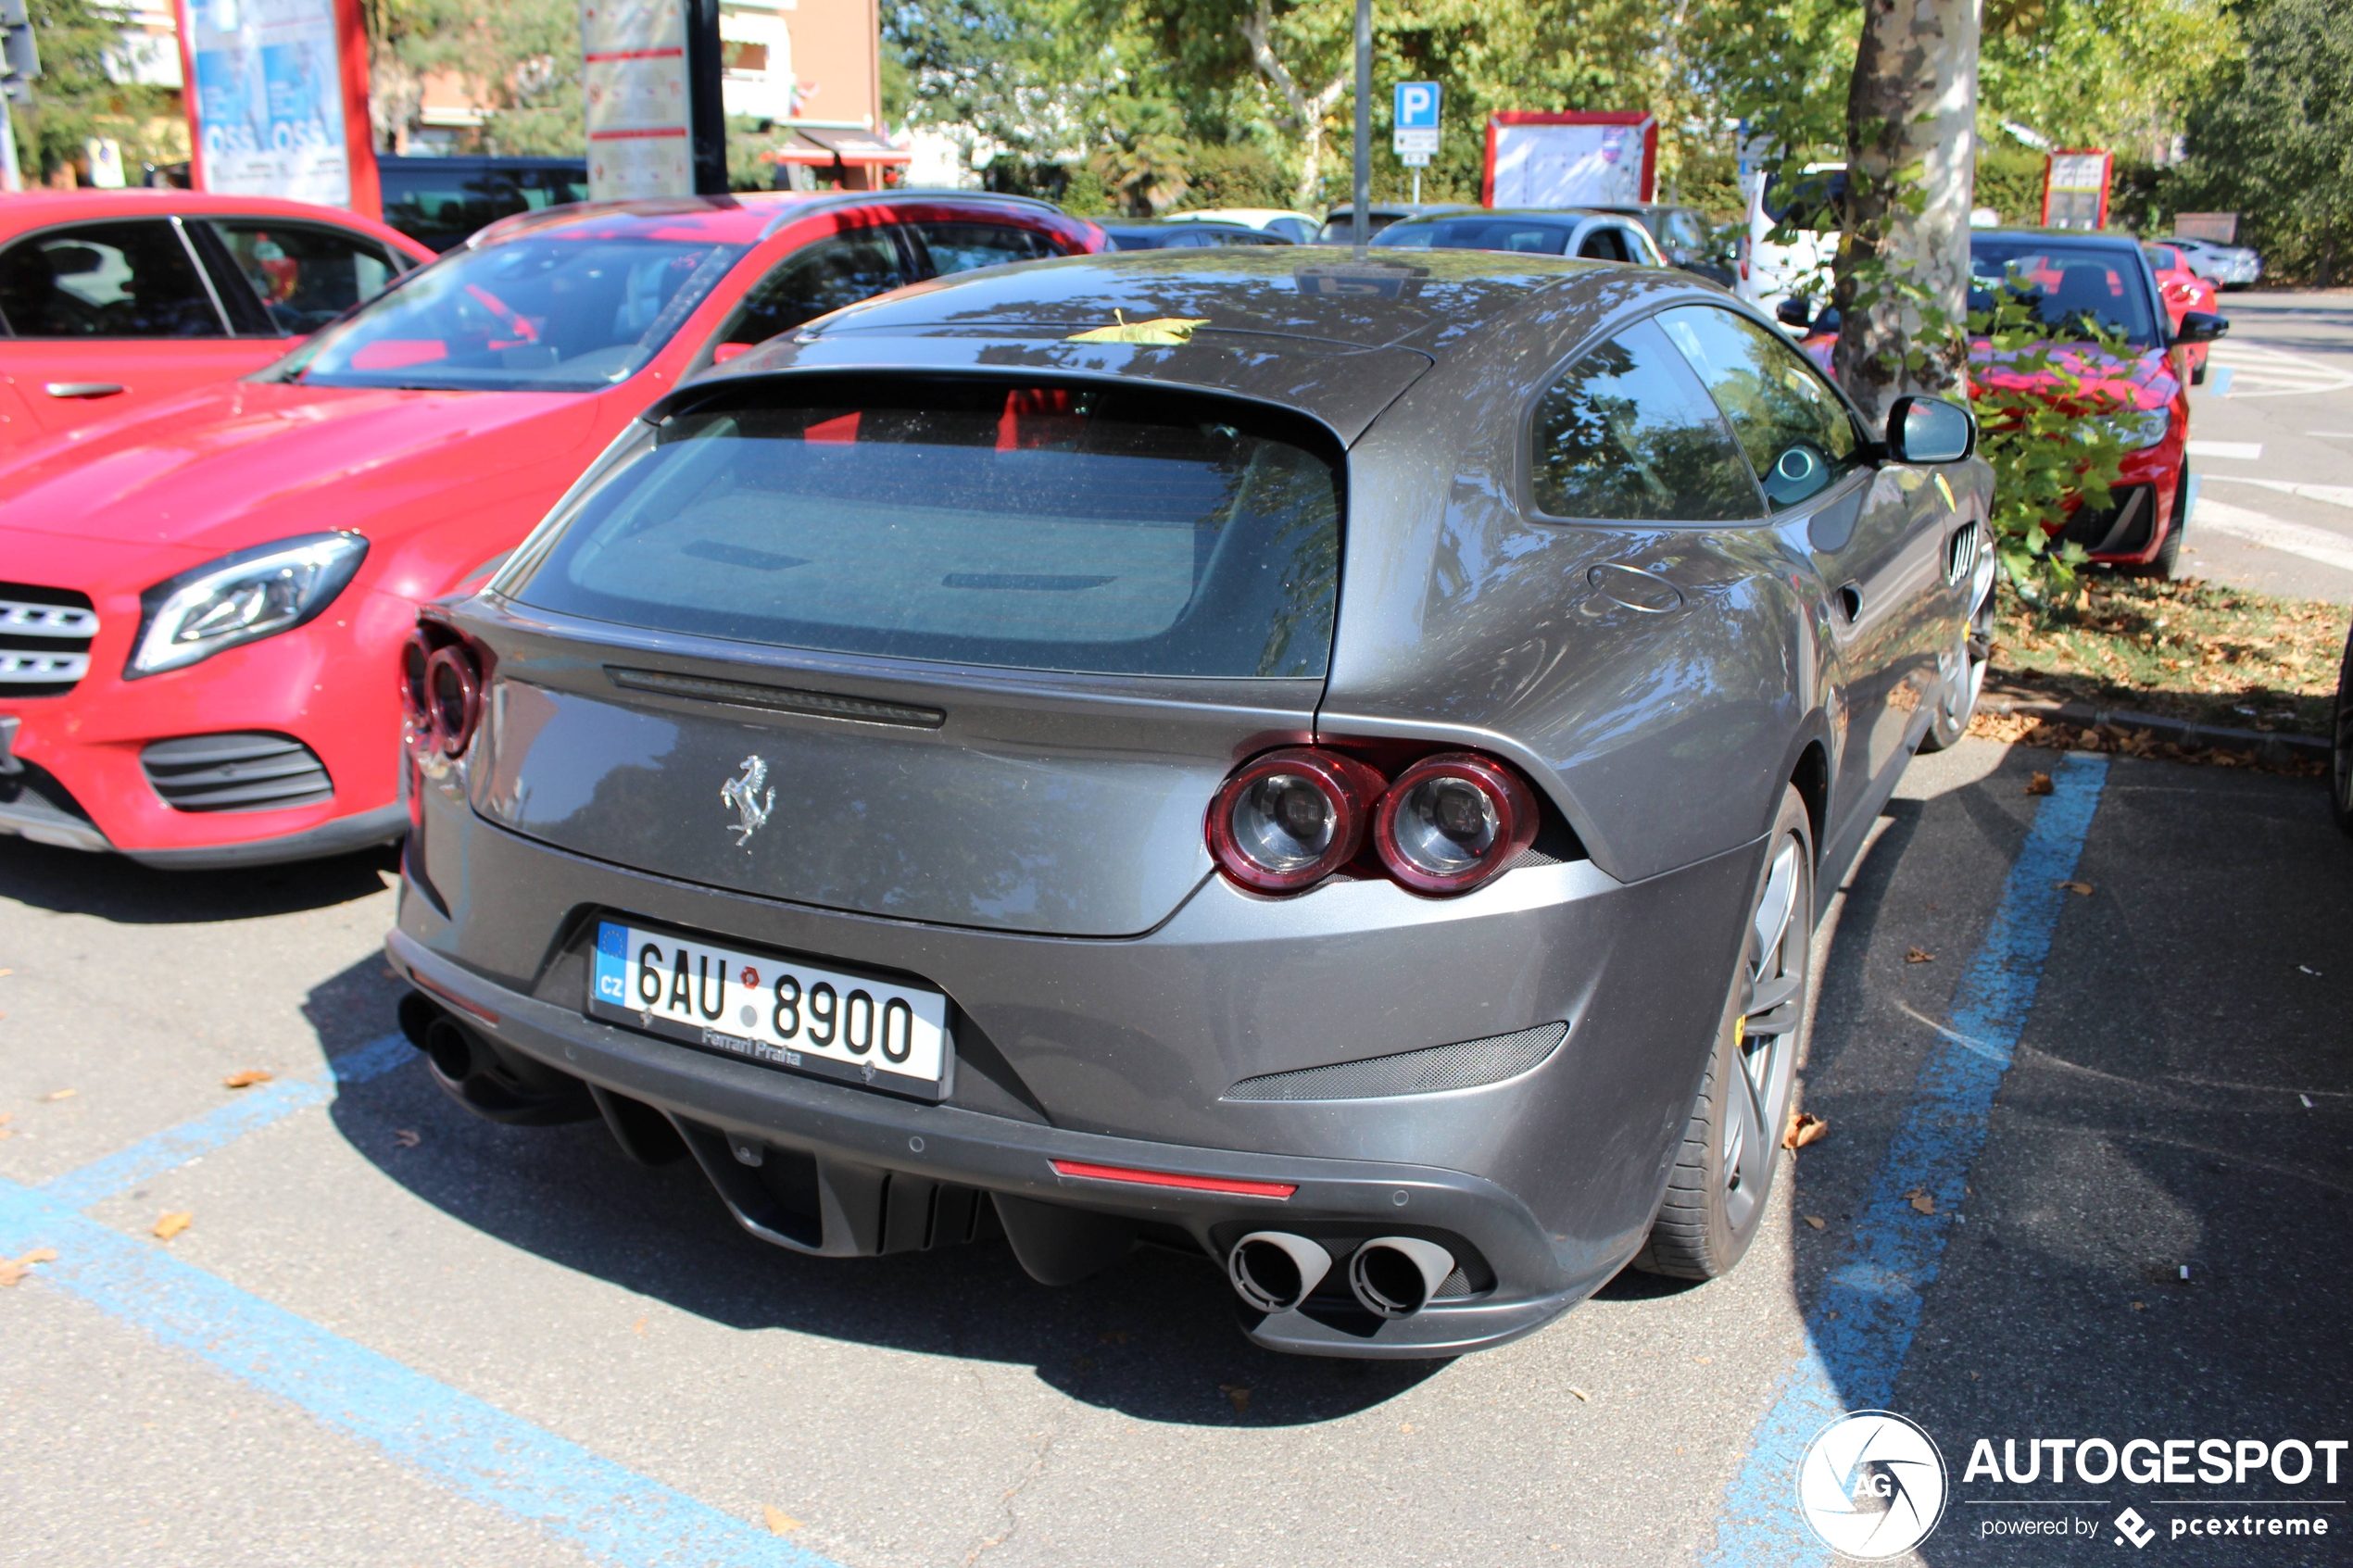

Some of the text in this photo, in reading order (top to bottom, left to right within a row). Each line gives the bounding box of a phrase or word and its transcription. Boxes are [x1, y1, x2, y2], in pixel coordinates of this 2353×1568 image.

[1403, 86, 1431, 123] P
[600, 974, 623, 997] CZ
[639, 943, 913, 1064] 6AU 8900
[701, 1025, 802, 1066] Ferrari Praha
